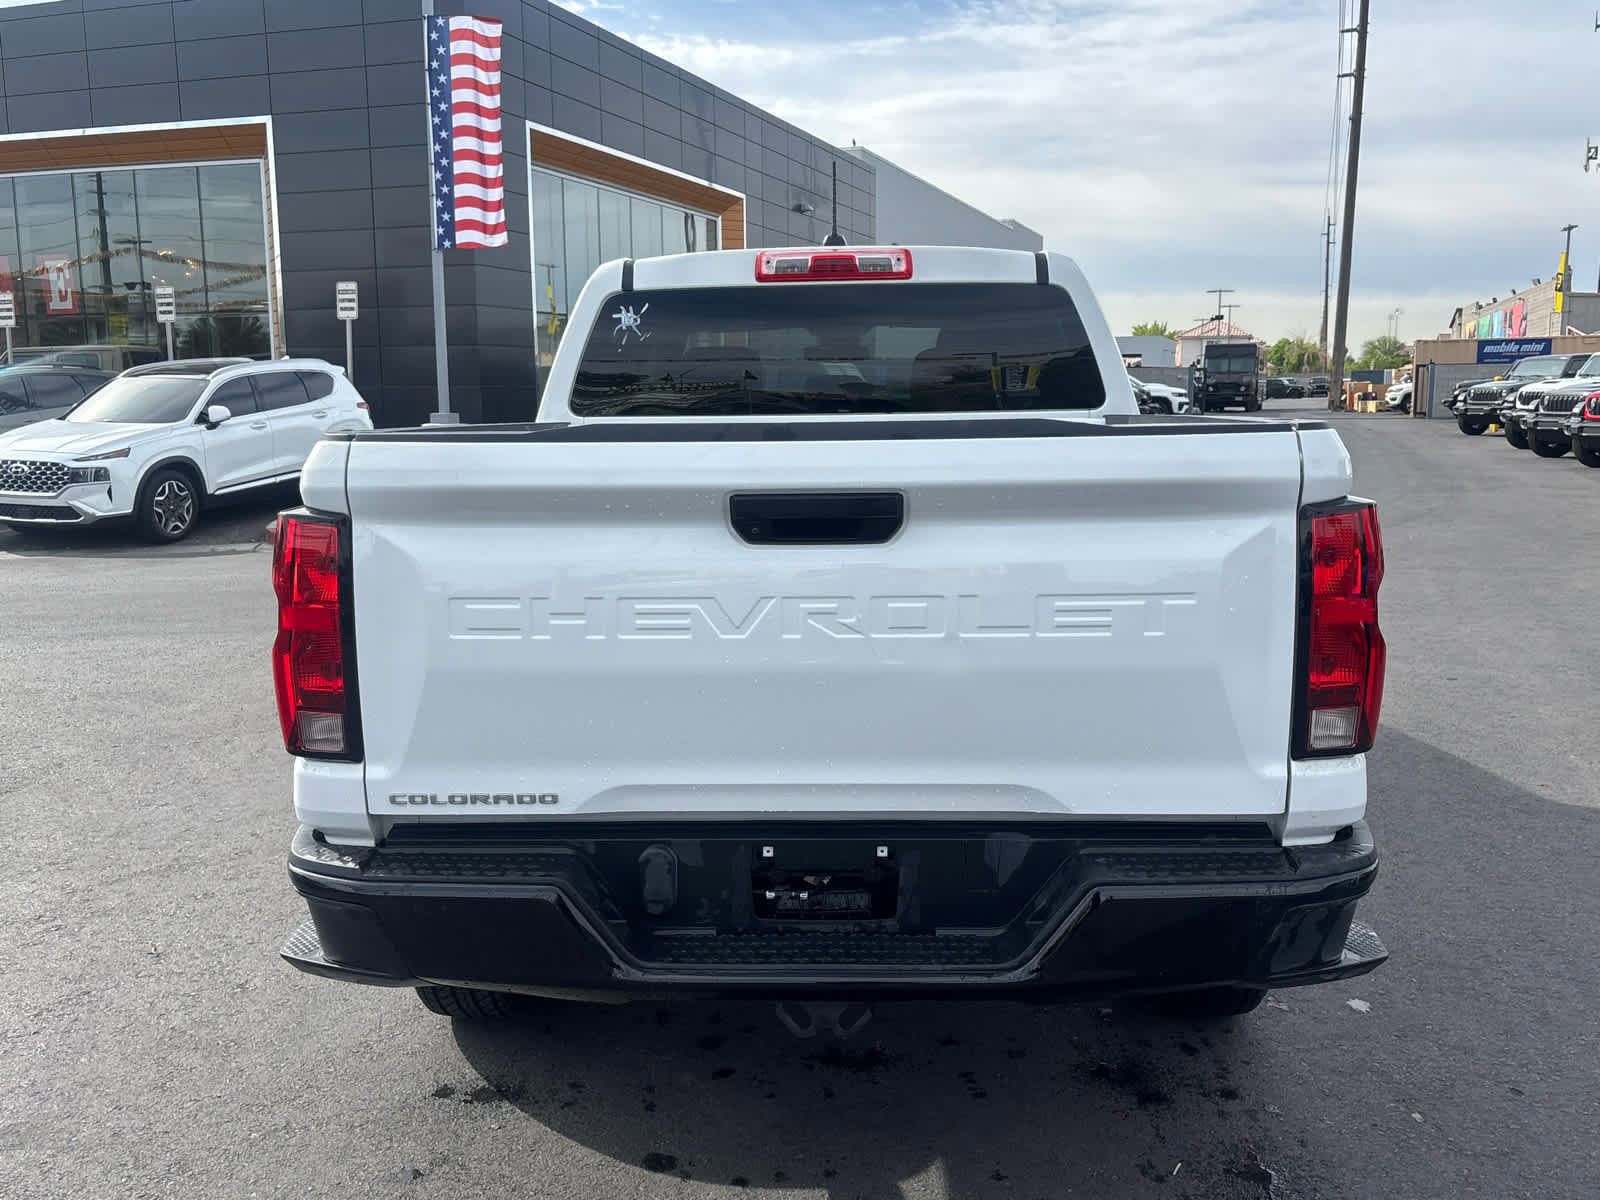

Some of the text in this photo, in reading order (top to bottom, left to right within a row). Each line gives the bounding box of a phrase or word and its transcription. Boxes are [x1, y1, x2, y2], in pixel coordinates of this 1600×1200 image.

[1483, 341, 1546, 353] mobile mini
[448, 593, 1197, 639] CHEVROLET
[388, 793, 560, 805] COLORADO
